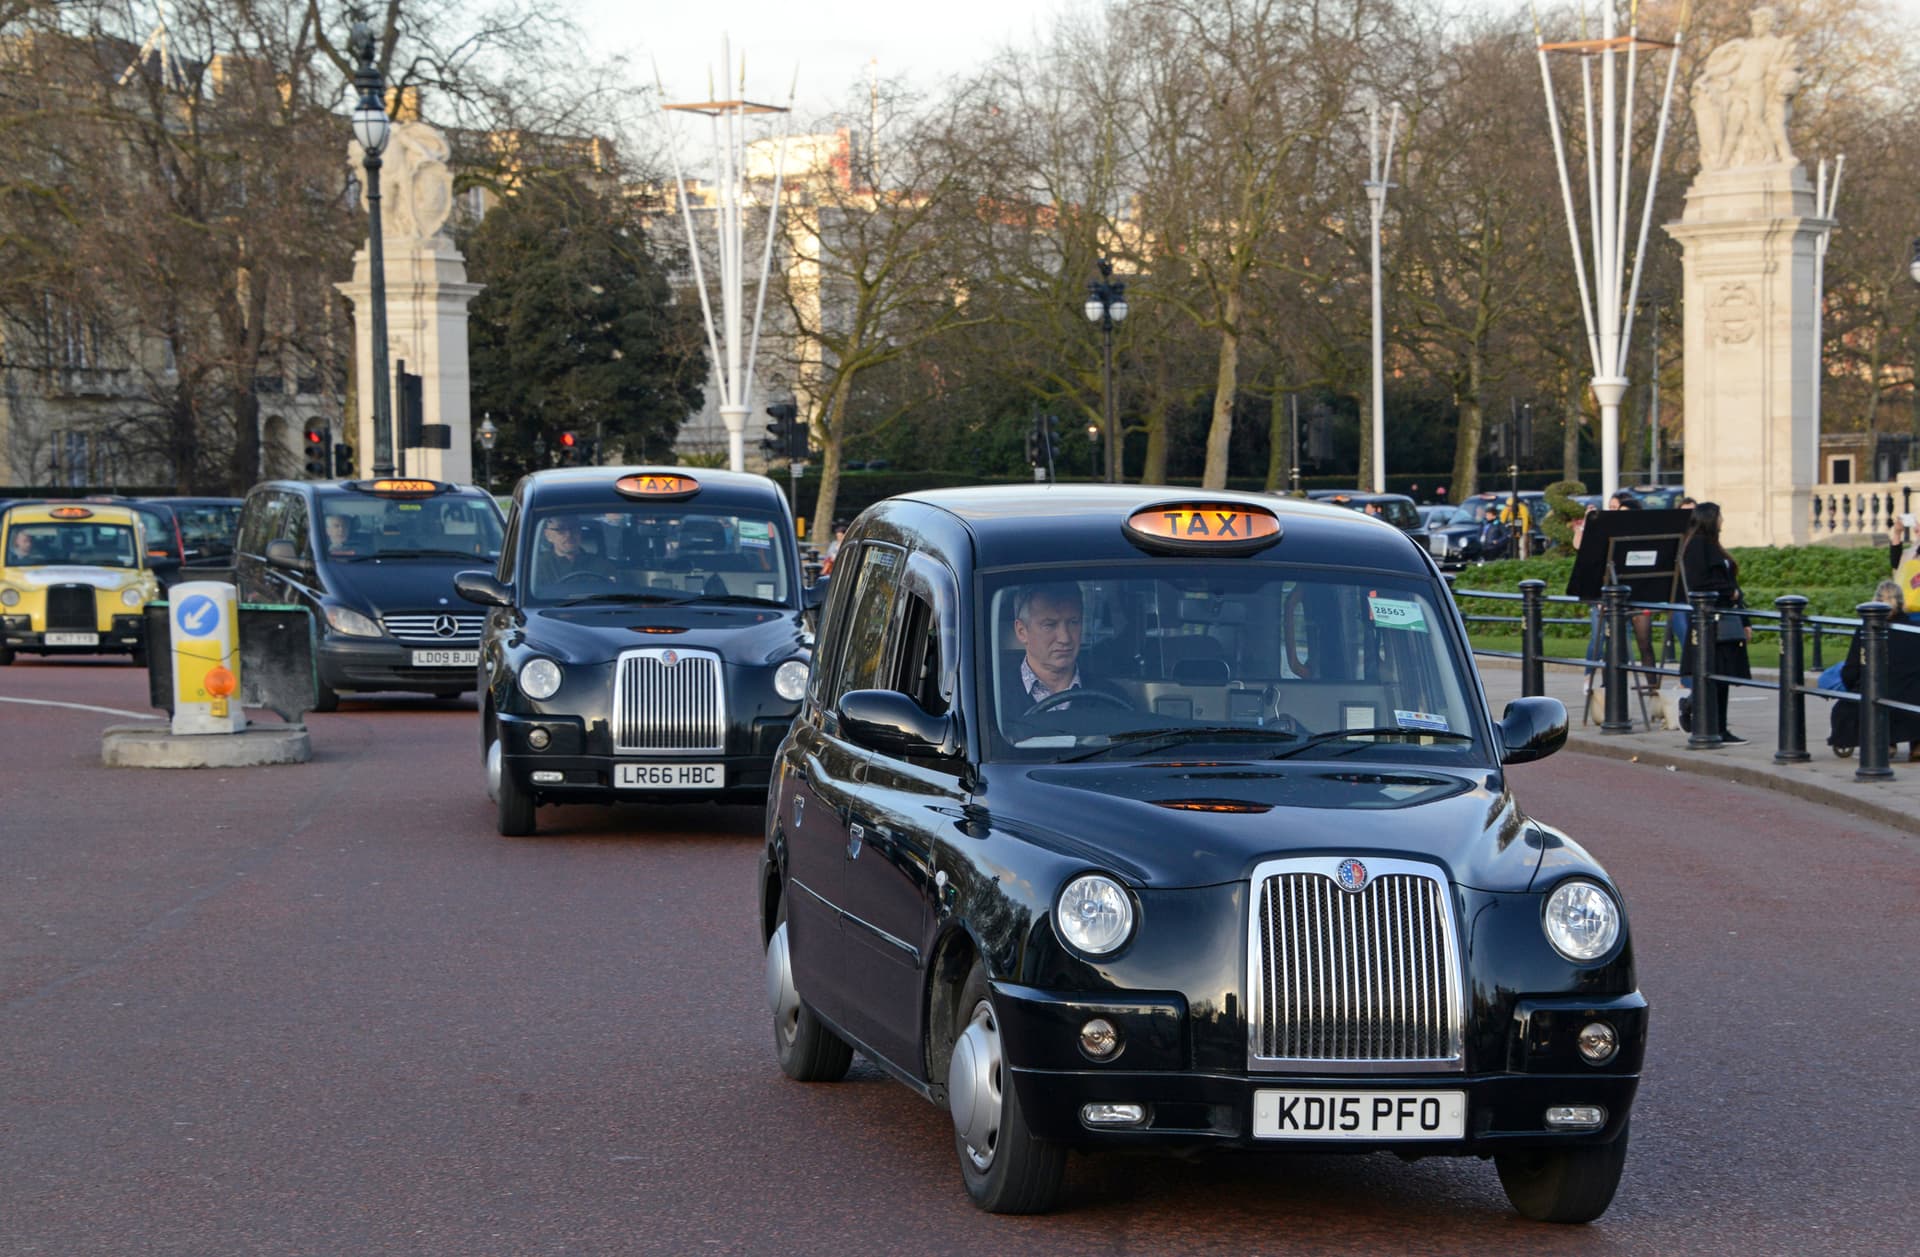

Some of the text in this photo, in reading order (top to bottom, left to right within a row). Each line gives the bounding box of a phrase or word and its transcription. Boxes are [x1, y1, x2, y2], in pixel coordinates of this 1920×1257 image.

[387, 481, 424, 491] TAXI
[635, 478, 683, 491] TAXI
[1163, 512, 1253, 537] TAXI
[1374, 606, 1406, 617] 28563
[417, 652, 476, 664] LD09 BJU
[623, 767, 715, 784] LR66 HBC
[1278, 1096, 1440, 1131] KD15 PFO
